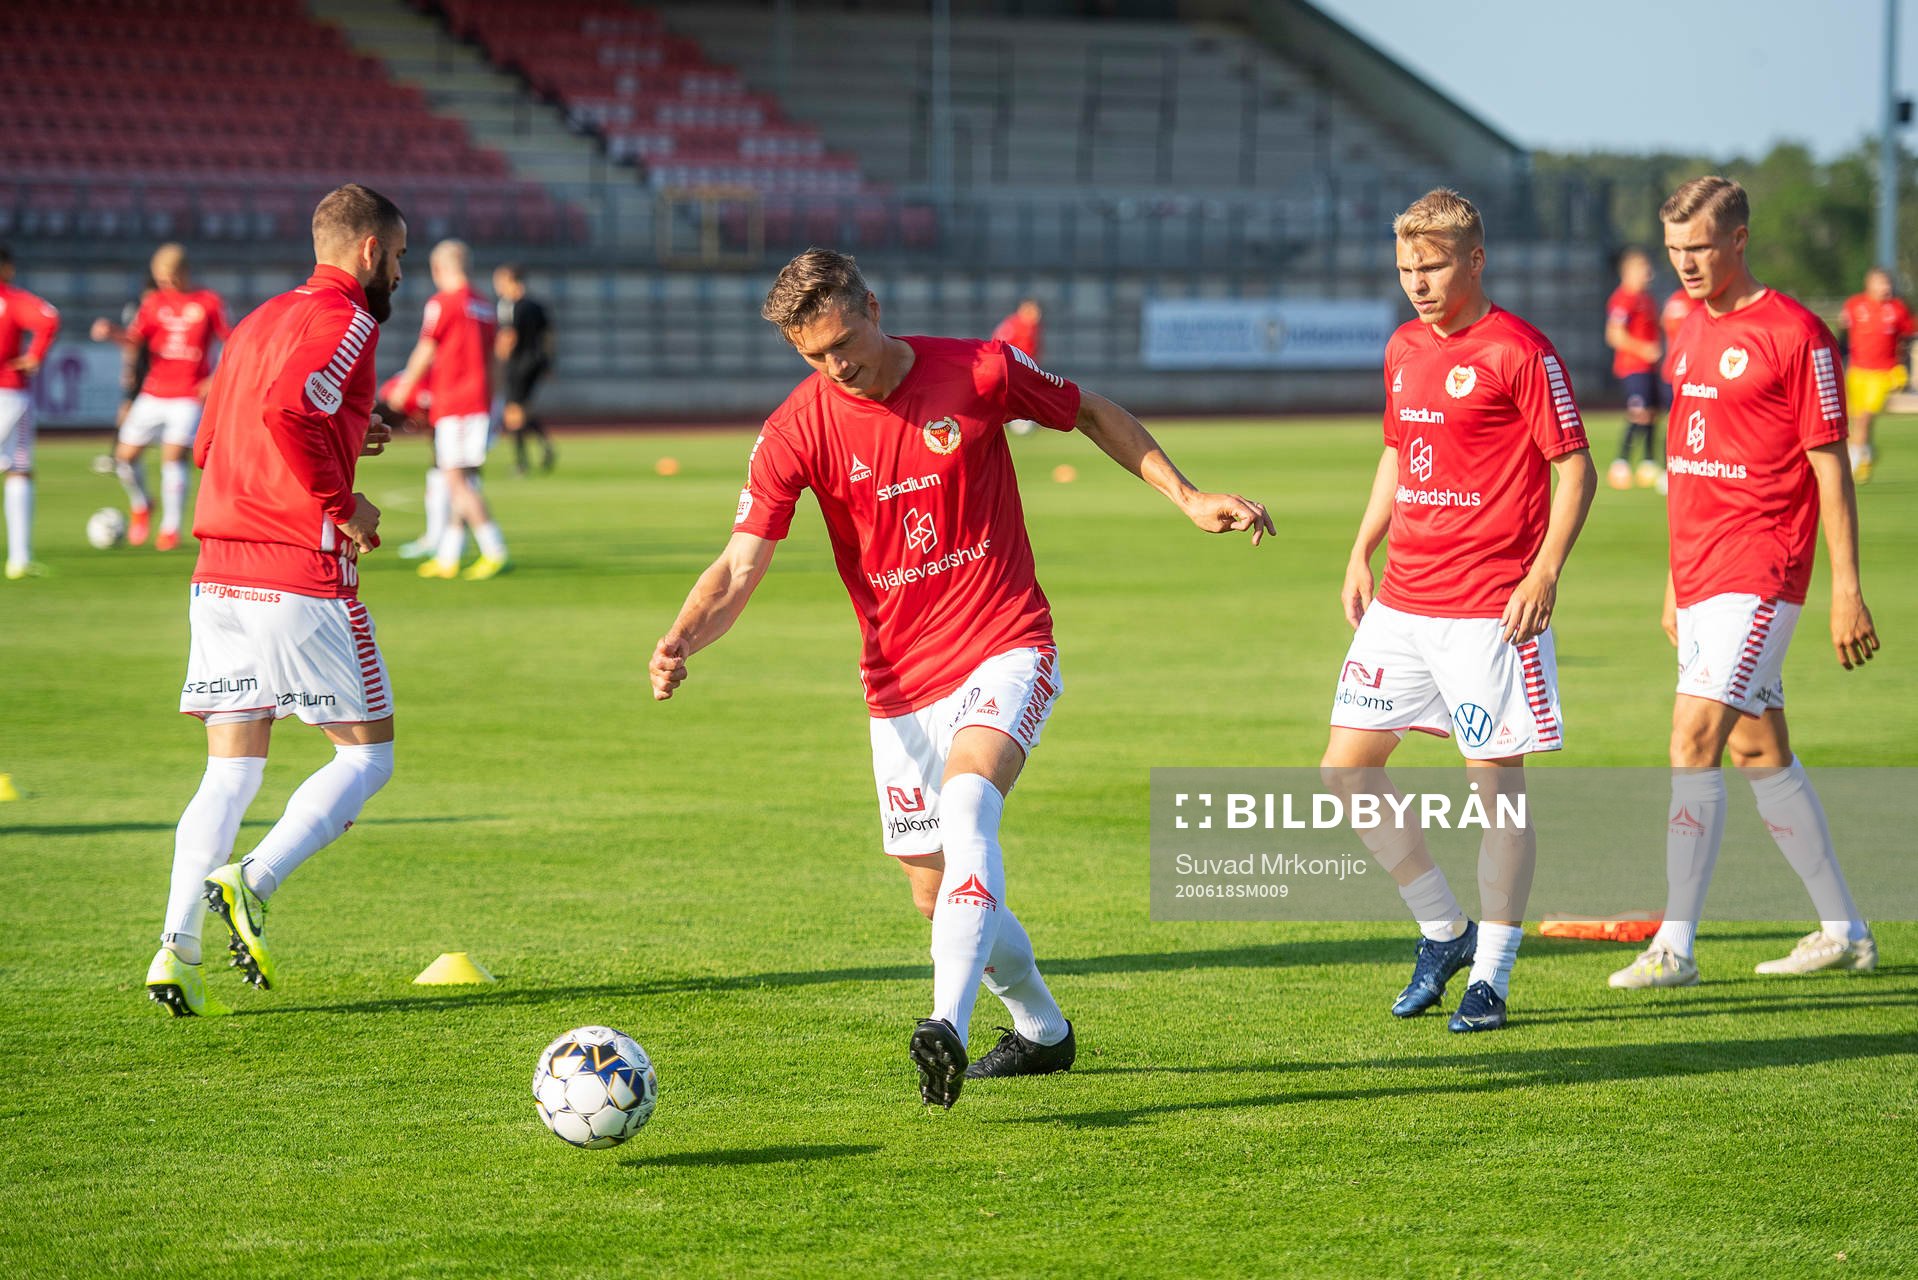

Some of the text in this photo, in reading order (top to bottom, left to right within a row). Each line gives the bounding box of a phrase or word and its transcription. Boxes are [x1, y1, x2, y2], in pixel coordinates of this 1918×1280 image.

[311, 377, 338, 405] UNIBET
[1400, 407, 1445, 425] stadium
[850, 469, 872, 484] SELECT
[877, 473, 941, 502] stadium
[887, 816, 940, 839] yblom
[947, 897, 996, 912] SELECT
